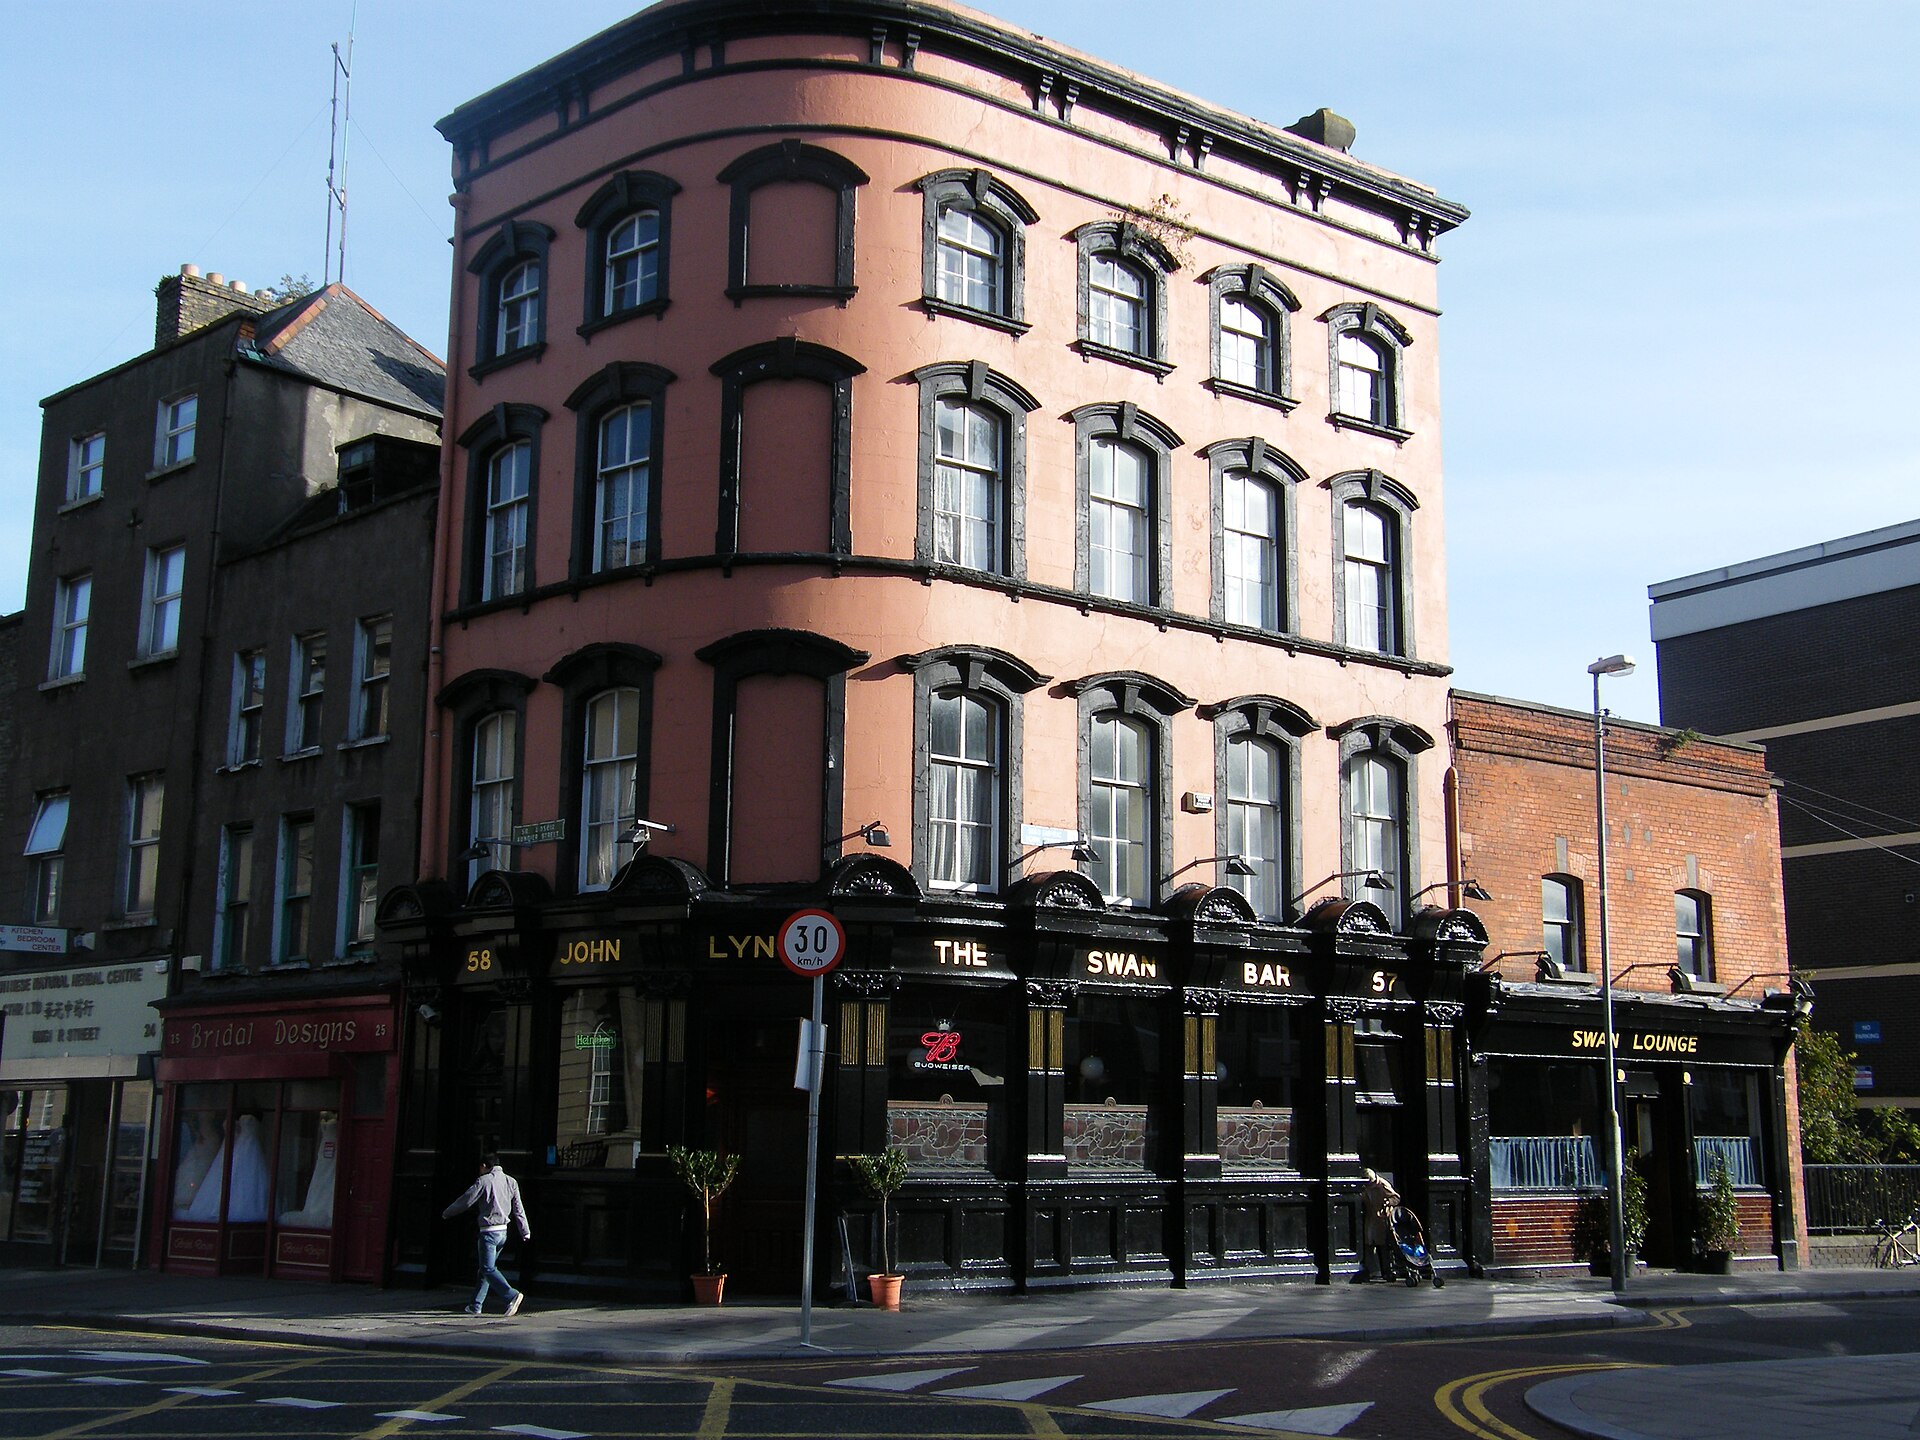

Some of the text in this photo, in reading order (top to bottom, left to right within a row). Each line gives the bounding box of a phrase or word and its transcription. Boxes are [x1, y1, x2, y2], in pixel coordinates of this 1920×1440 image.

[11, 927, 44, 935] KITCHEN
[17, 935, 56, 943] BEDROOM
[794, 925, 828, 953] 30
[32, 943, 61, 951] CENTER
[560, 938, 621, 965] JOHN
[467, 949, 492, 972] 58
[797, 956, 823, 966] km/h
[933, 940, 1399, 993] THE SWAN BAR 57
[33, 974, 70, 991] NATURAL
[72, 971, 105, 987] HERBAL
[106, 967, 144, 984] CENTRE
[66, 1026, 100, 1042] STREET
[191, 1022, 255, 1050] Bridal
[274, 1018, 358, 1050] Designs
[375, 1023, 386, 1037] 25
[577, 1034, 614, 1045] Heineken
[1572, 1030, 1699, 1053] SWAN LOUNGE
[1855, 1032, 1880, 1040] PARKING
[914, 1061, 972, 1071] BUDWEISER
